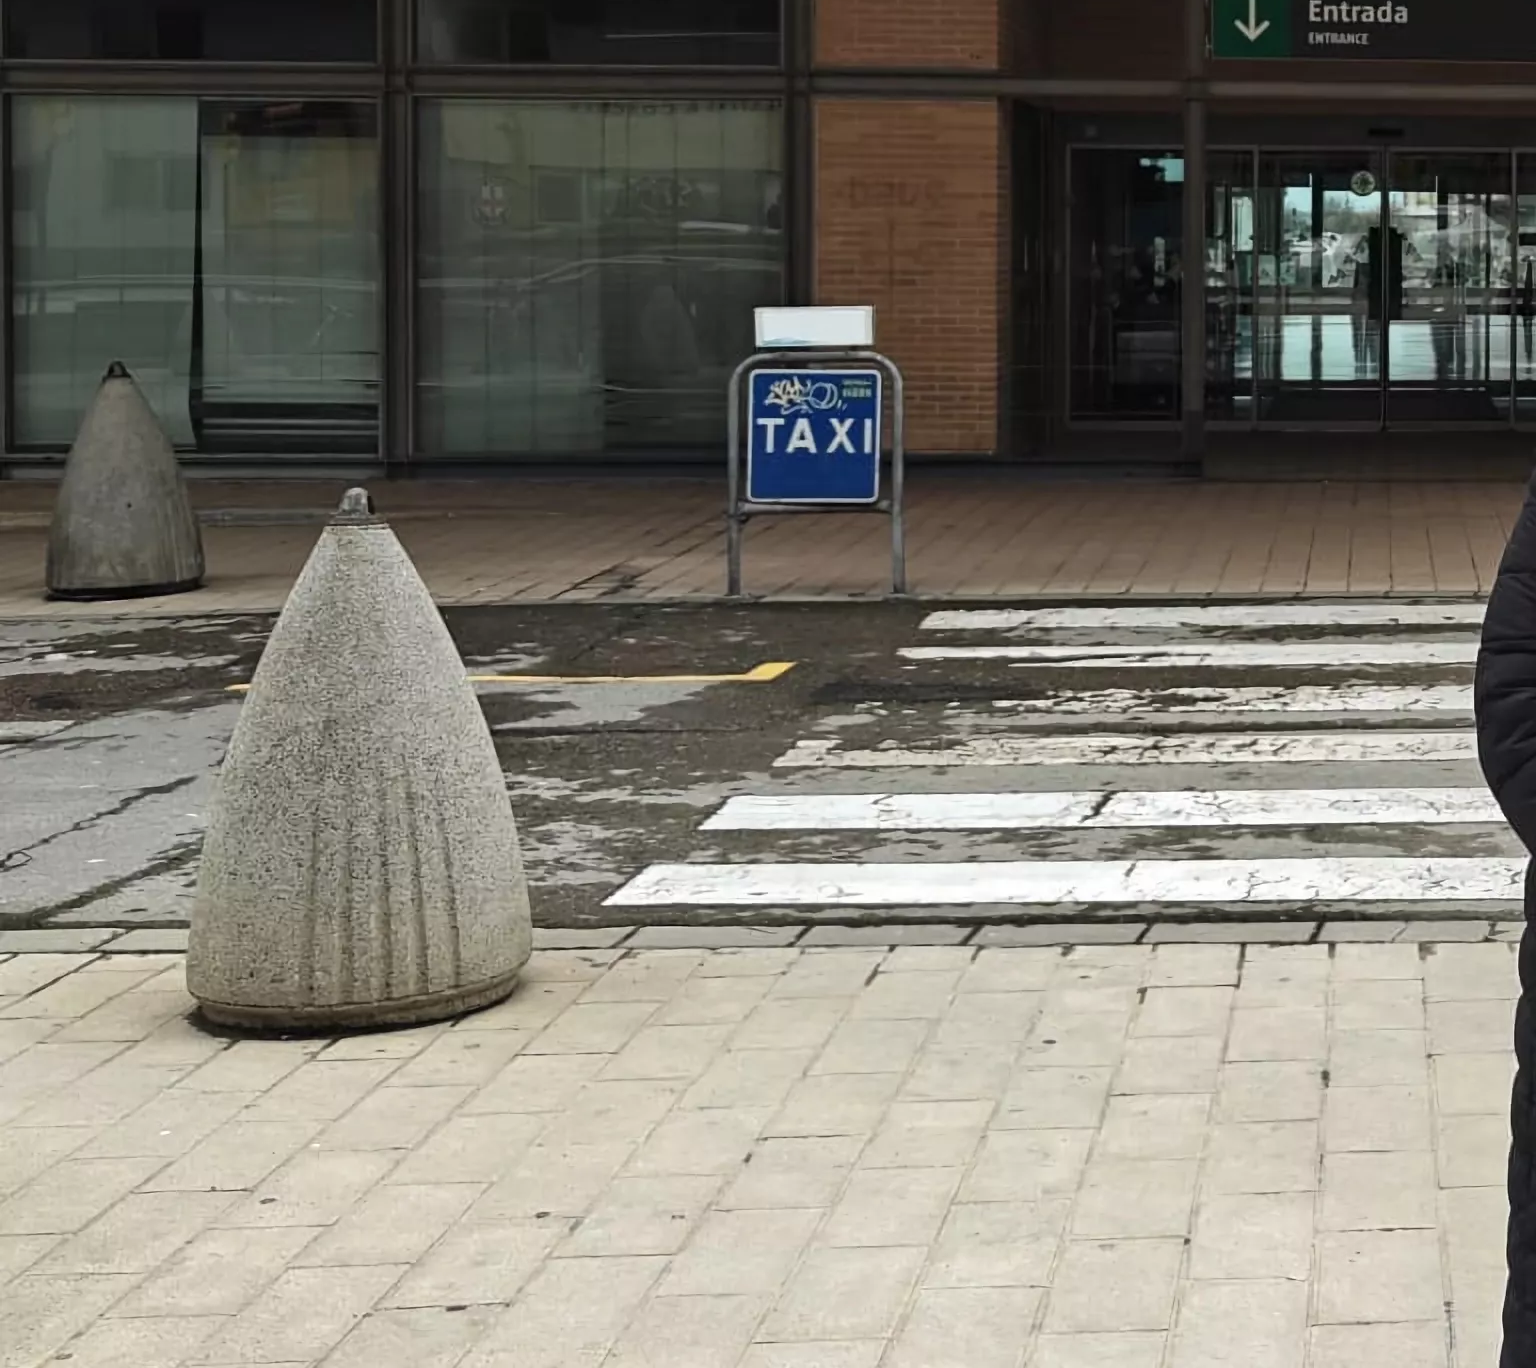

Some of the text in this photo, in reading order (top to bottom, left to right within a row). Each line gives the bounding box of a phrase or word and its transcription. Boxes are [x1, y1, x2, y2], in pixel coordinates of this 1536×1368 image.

[1308, 0, 1409, 24] Entrada
[1307, 31, 1370, 45] ENTRANCE
[756, 417, 873, 454] TAXI
